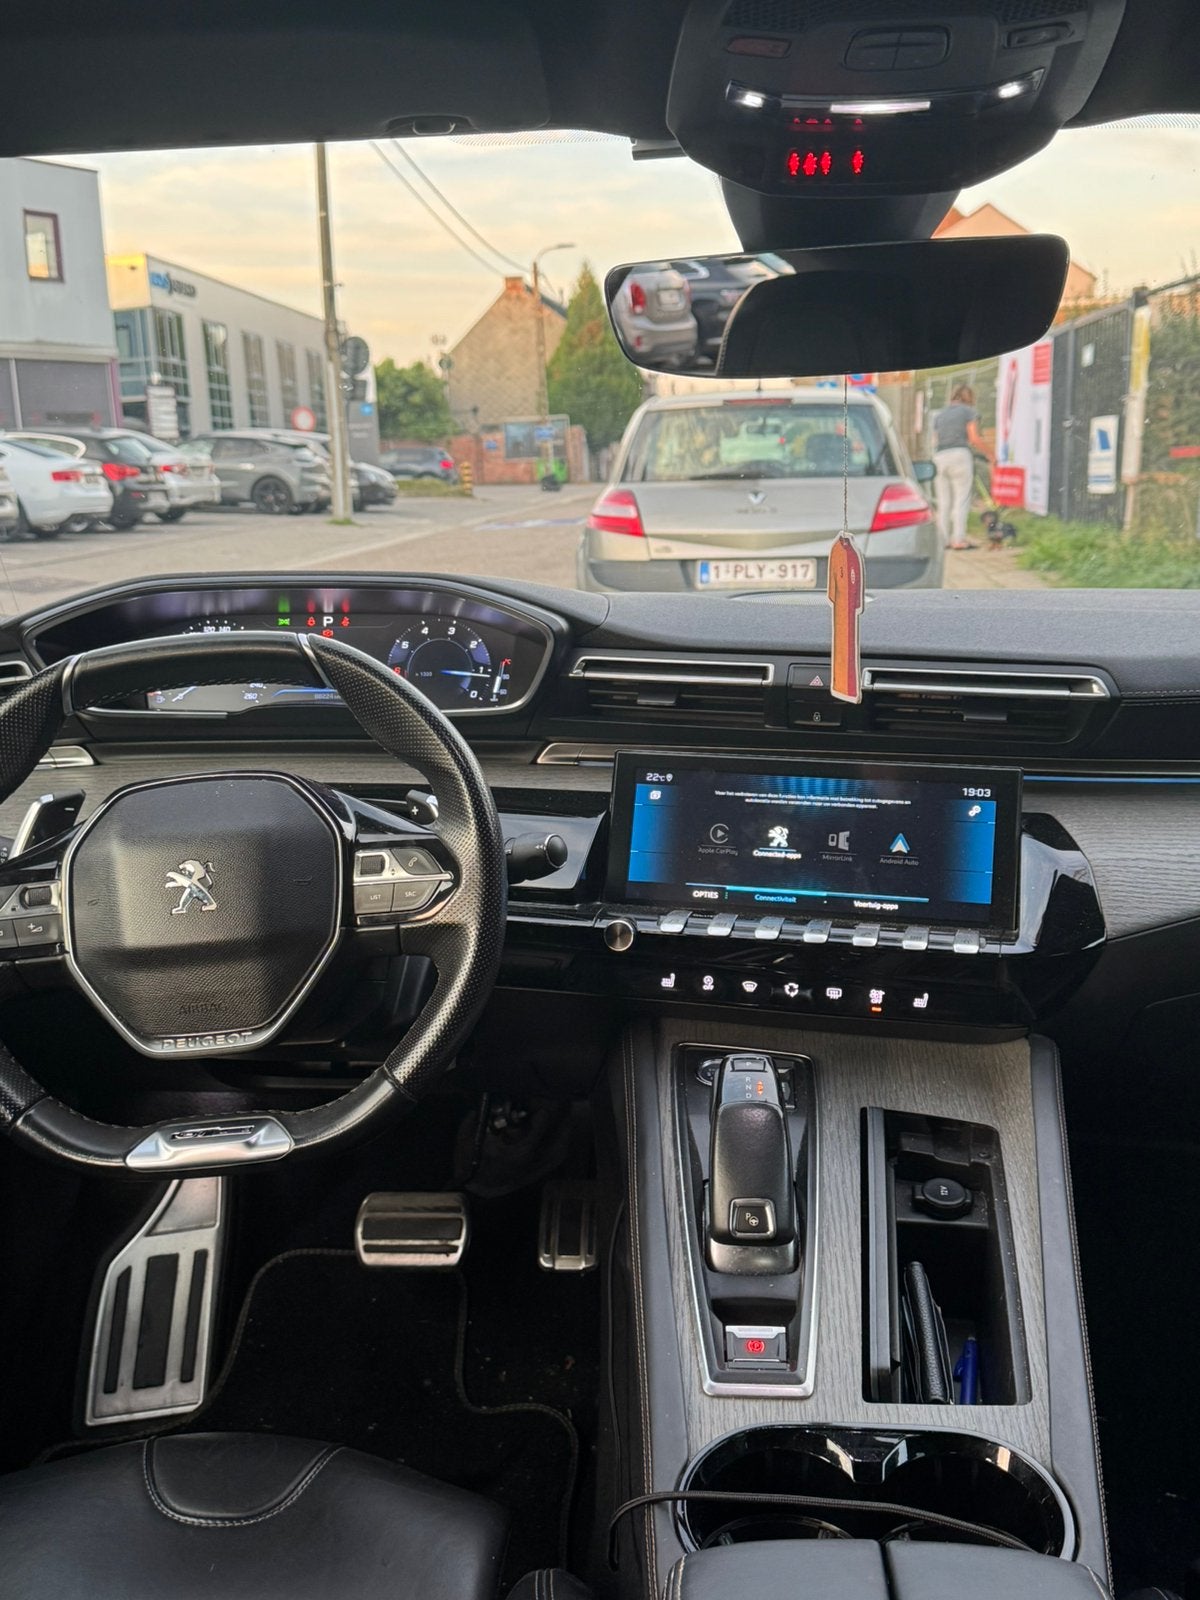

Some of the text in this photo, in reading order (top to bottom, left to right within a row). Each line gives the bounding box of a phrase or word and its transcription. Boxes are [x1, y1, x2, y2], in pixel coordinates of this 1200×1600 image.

[323, 616, 334, 627] P
[421, 627, 429, 635] 4
[447, 627, 456, 635] 3
[401, 641, 409, 649] 5
[469, 640, 478, 649] 2
[479, 666, 484, 674] 1
[469, 690, 478, 698] 0
[962, 787, 992, 797] 19:03
[822, 854, 853, 862] MirrorLink
[880, 857, 904, 865] Android
[692, 890, 719, 899] OPTIES
[161, 1032, 253, 1050] PEUGEOT
